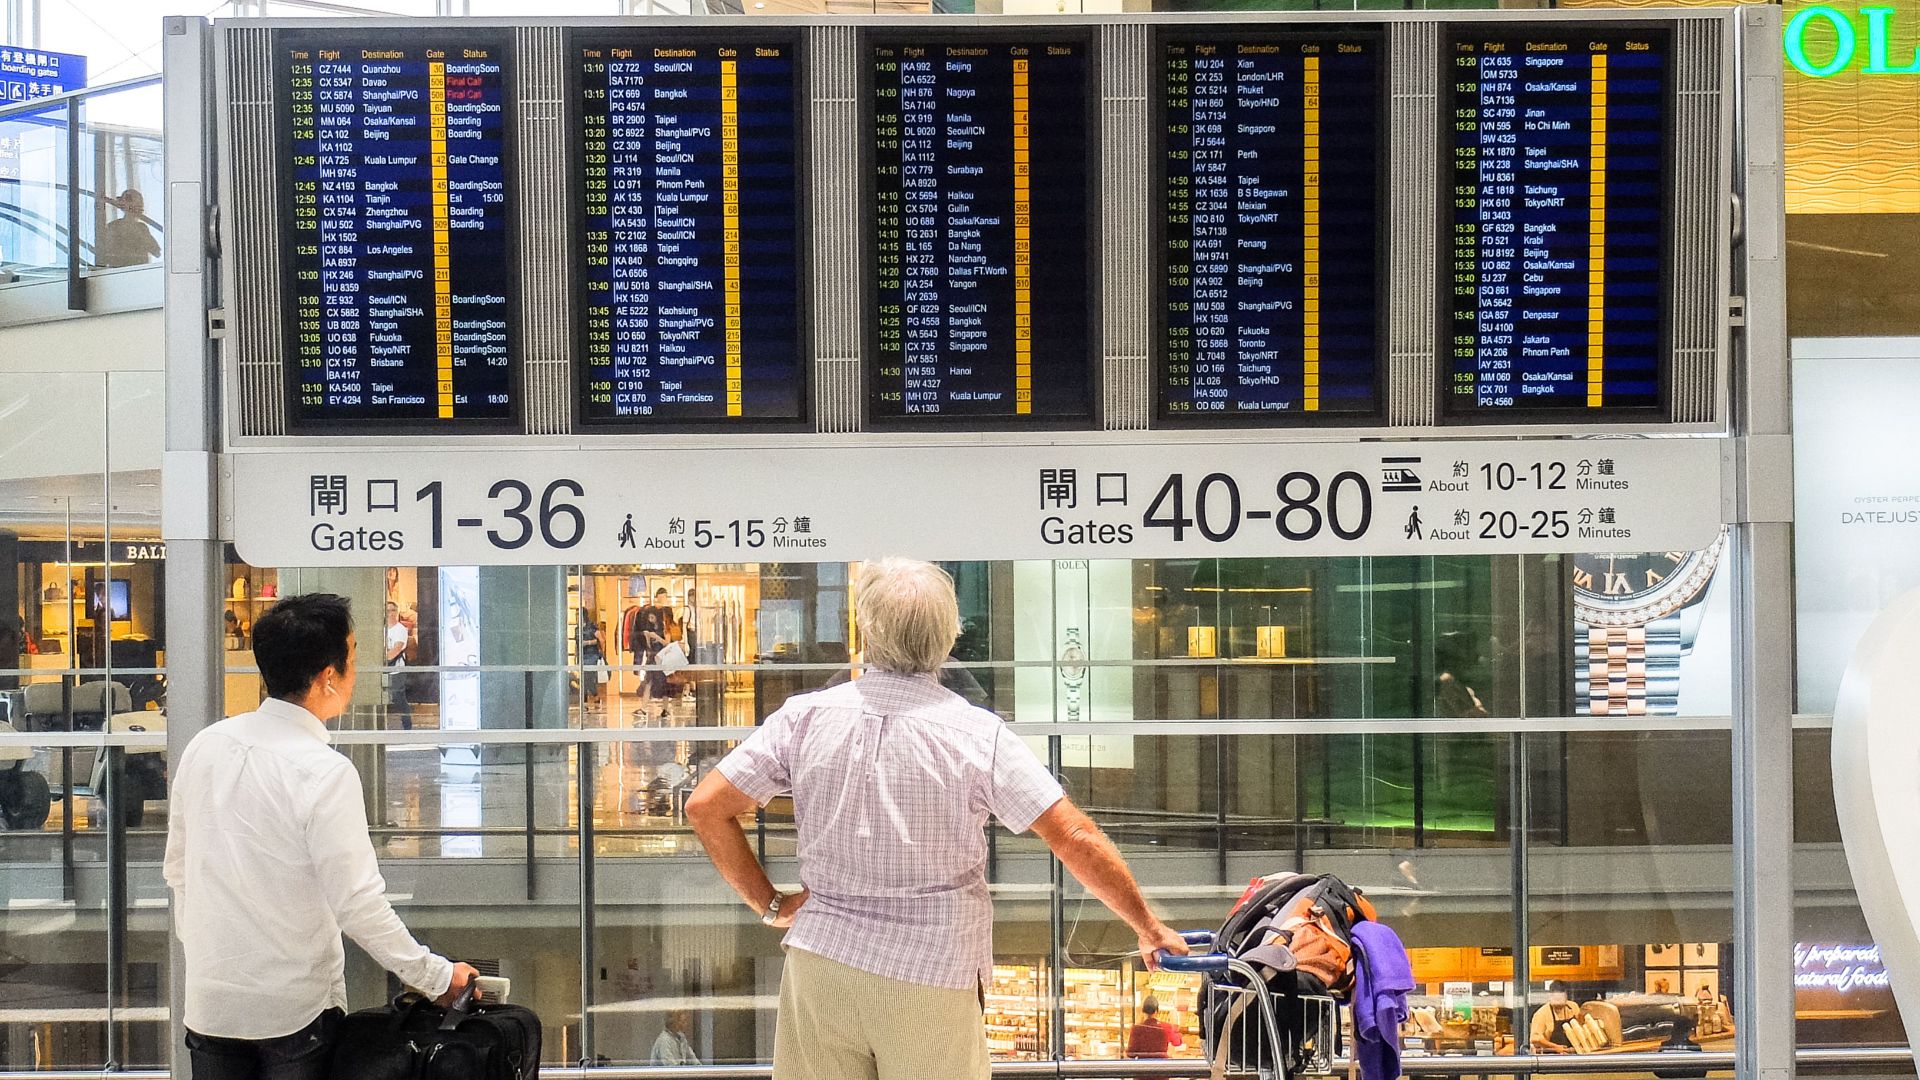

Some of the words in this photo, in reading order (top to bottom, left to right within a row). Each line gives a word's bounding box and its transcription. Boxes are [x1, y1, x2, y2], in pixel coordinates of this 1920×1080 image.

[1456, 43, 1474, 52] Time
[1484, 43, 1505, 52] Flight
[1526, 42, 1568, 51] Destination
[1589, 42, 1608, 51] Gate
[1625, 42, 1649, 51] Status
[1784, 5, 1920, 78] OL
[583, 49, 601, 57] Time
[611, 49, 632, 58] Flight
[654, 48, 696, 57] Destination
[718, 48, 737, 57] Gate
[755, 48, 779, 57] Status
[875, 48, 894, 56] Time
[904, 48, 925, 57] Flight
[946, 47, 988, 56] Destination
[1010, 47, 1029, 56] Gate
[1047, 47, 1071, 55] Status
[1167, 46, 1185, 54] Time
[1195, 45, 1216, 54] Flight
[1238, 45, 1279, 53] Destination
[1301, 45, 1320, 53] Gate
[1337, 44, 1362, 53] Status
[291, 51, 308, 59] Time
[319, 50, 340, 60] Flight
[362, 50, 404, 59] Destination
[426, 50, 445, 58] Gate
[463, 50, 487, 58] Status
[584, 64, 604, 72] 13:10
[612, 64, 624, 72] OZ
[625, 63, 640, 72] 722
[654, 63, 693, 72] Seoul/ICN
[875, 63, 896, 72] 14:00
[904, 62, 915, 71] KA
[916, 62, 931, 71] 992
[946, 62, 972, 73] Beijing
[1456, 58, 1476, 66] 15:20
[1483, 57, 1495, 66] CX
[1497, 57, 1511, 66] 635
[1525, 57, 1563, 68] Singapore
[1, 63, 36, 76] boarding
[291, 65, 312, 74] 12:15
[319, 65, 331, 73] CZ
[332, 65, 352, 73] 7444
[362, 65, 401, 74] Quanzhou
[446, 64, 500, 74] BoardingSoon
[291, 78, 313, 87] 12:35
[320, 78, 332, 87] CX
[333, 78, 352, 86] 5347
[363, 78, 387, 86] Davao
[431, 78, 443, 86] 506
[447, 77, 465, 86] Final
[467, 77, 482, 86] Call
[1167, 74, 1187, 82] 14:40
[1195, 73, 1207, 82] CX
[1209, 73, 1223, 81] 253
[1237, 72, 1284, 81] London/LHR
[293, 117, 313, 126] 12:40
[321, 117, 335, 126] MM
[337, 117, 351, 125] 064
[363, 116, 416, 126] Osaka/Kansai
[448, 116, 482, 127] Boarding
[585, 168, 606, 176] 13:20
[614, 167, 625, 176] PR
[627, 167, 642, 176] 319
[656, 167, 681, 176] Manila
[728, 167, 737, 175] 36
[1455, 186, 1476, 195] 15:30
[1482, 186, 1495, 194] AE
[1496, 186, 1515, 194] 1818
[1524, 185, 1557, 196] Taichung
[295, 195, 316, 203] 12:50
[323, 195, 335, 203] KA
[336, 195, 354, 203] 1104
[366, 194, 391, 205] Tianjin
[450, 194, 462, 202] Est
[483, 194, 503, 202] 15:00
[1168, 202, 1188, 211] 14:55
[1195, 202, 1207, 210] CZ
[1209, 202, 1228, 210] 3044
[1238, 201, 1267, 210] Meixian
[878, 255, 899, 264] 14:15
[906, 255, 918, 264] HX
[920, 255, 934, 263] 272
[949, 255, 986, 265] Nanchang
[1016, 255, 1029, 263] 204
[589, 320, 610, 328] 13:45
[617, 319, 628, 328] KA
[630, 319, 648, 328] 5360
[659, 318, 714, 328] Shanghai/PVG
[1454, 373, 1474, 382] 15:50
[1480, 373, 1495, 381] MM
[1496, 373, 1511, 381] 060
[1522, 372, 1573, 381] Osaka/Kansai
[302, 396, 323, 405] 13:10
[329, 395, 341, 404] EY
[342, 395, 361, 404] 4294
[372, 395, 387, 404] San
[389, 395, 425, 404] Francisco
[455, 395, 467, 403] Est
[488, 395, 508, 403] 18:00
[880, 392, 901, 401] 14:35
[908, 392, 921, 400] MH
[923, 392, 937, 400] 073
[950, 391, 972, 400] Kuala
[973, 391, 1001, 402] Lumpur
[1018, 392, 1029, 400] 217
[1169, 402, 1189, 411] 15:15
[1196, 402, 1209, 410] OD
[1211, 401, 1225, 410] 606
[1238, 401, 1259, 409] Kuala
[1261, 401, 1289, 411] Lumpur
[1452, 460, 1469, 477] 約
[1576, 458, 1616, 476] 分鐘
[1429, 480, 1469, 492] About
[1479, 462, 1566, 490] 10-12
[1040, 468, 1129, 510] 閘口
[1576, 478, 1629, 489] Minutes
[310, 474, 399, 516] 閘口
[1041, 517, 1134, 545] Gates
[1142, 471, 1372, 542] 40-80
[311, 523, 404, 551] Gates
[416, 479, 586, 549] 1-36
[1453, 508, 1470, 526] 約
[1577, 507, 1616, 525] 分鐘
[669, 518, 686, 535] 約
[772, 516, 811, 534] 分鐘
[1430, 528, 1470, 539] About
[1478, 510, 1570, 539] 20-25
[644, 536, 685, 548] About
[693, 519, 766, 548] 5-15
[1578, 526, 1631, 538] Minutes
[773, 535, 827, 548] Minutes
